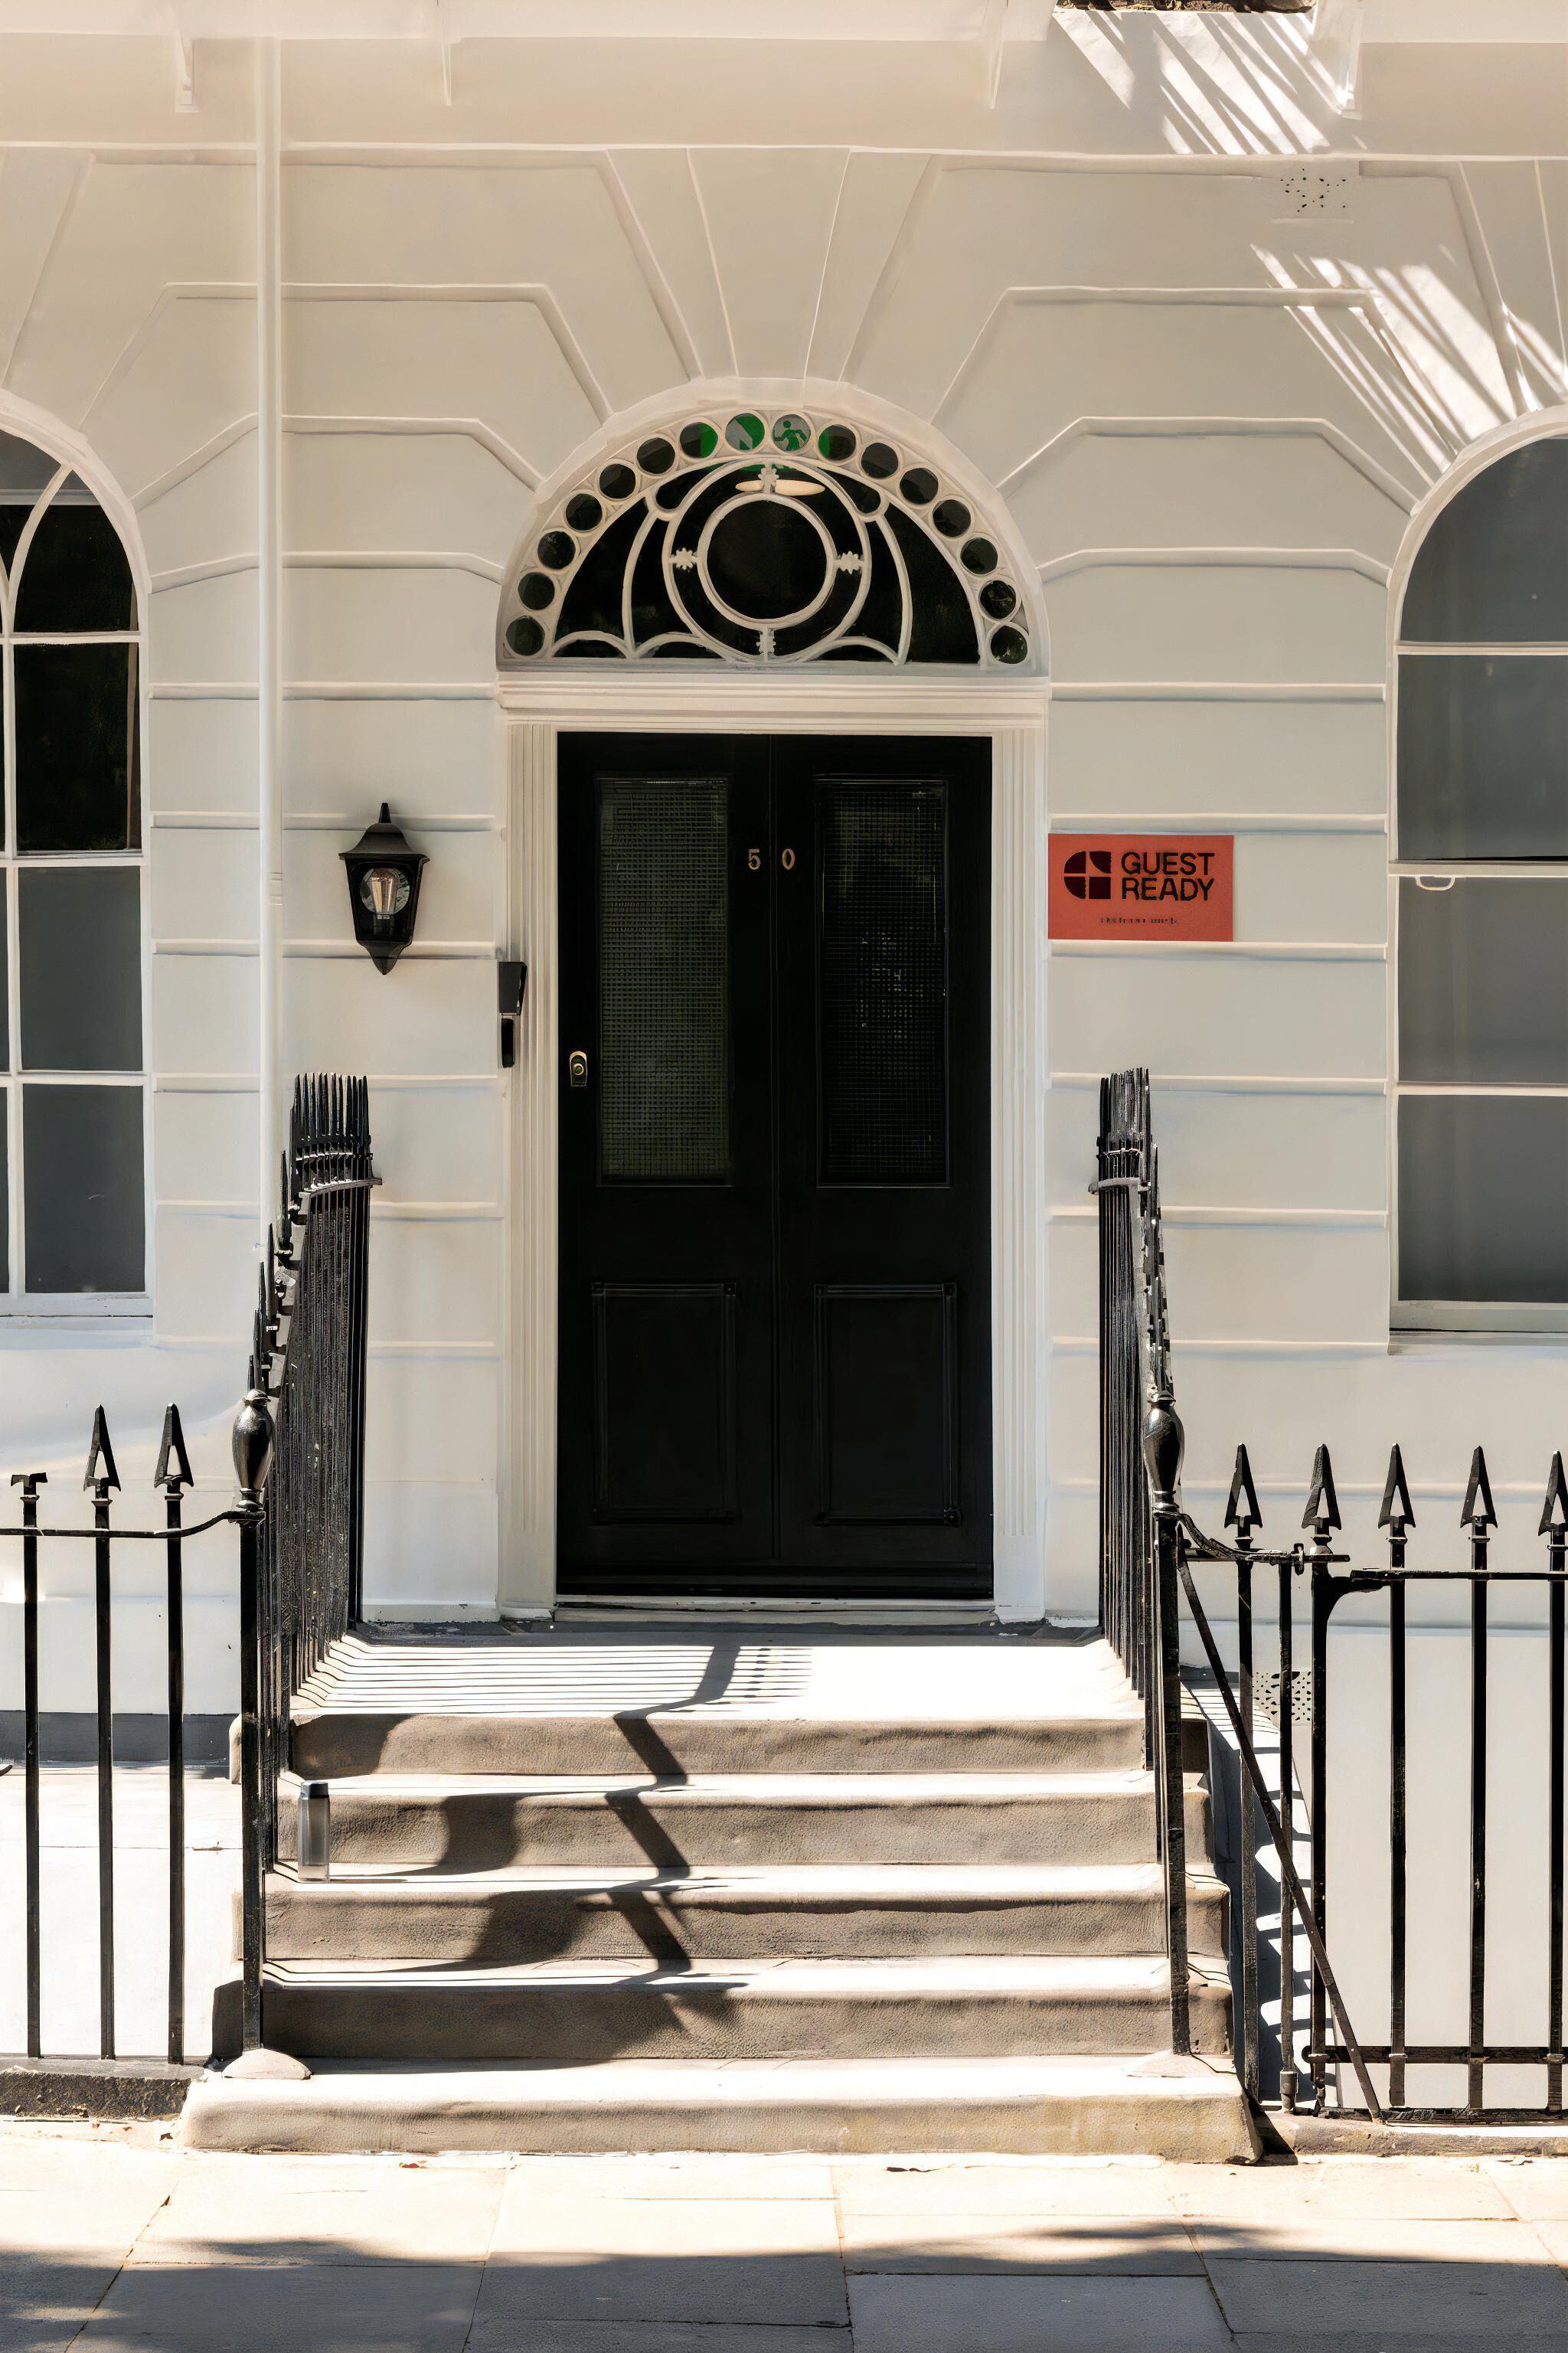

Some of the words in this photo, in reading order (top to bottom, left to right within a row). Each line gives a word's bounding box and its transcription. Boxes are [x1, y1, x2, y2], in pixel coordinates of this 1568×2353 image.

[748, 848, 795, 871] 50
[1121, 851, 1215, 876] GUEST
[1122, 877, 1214, 901] READY
